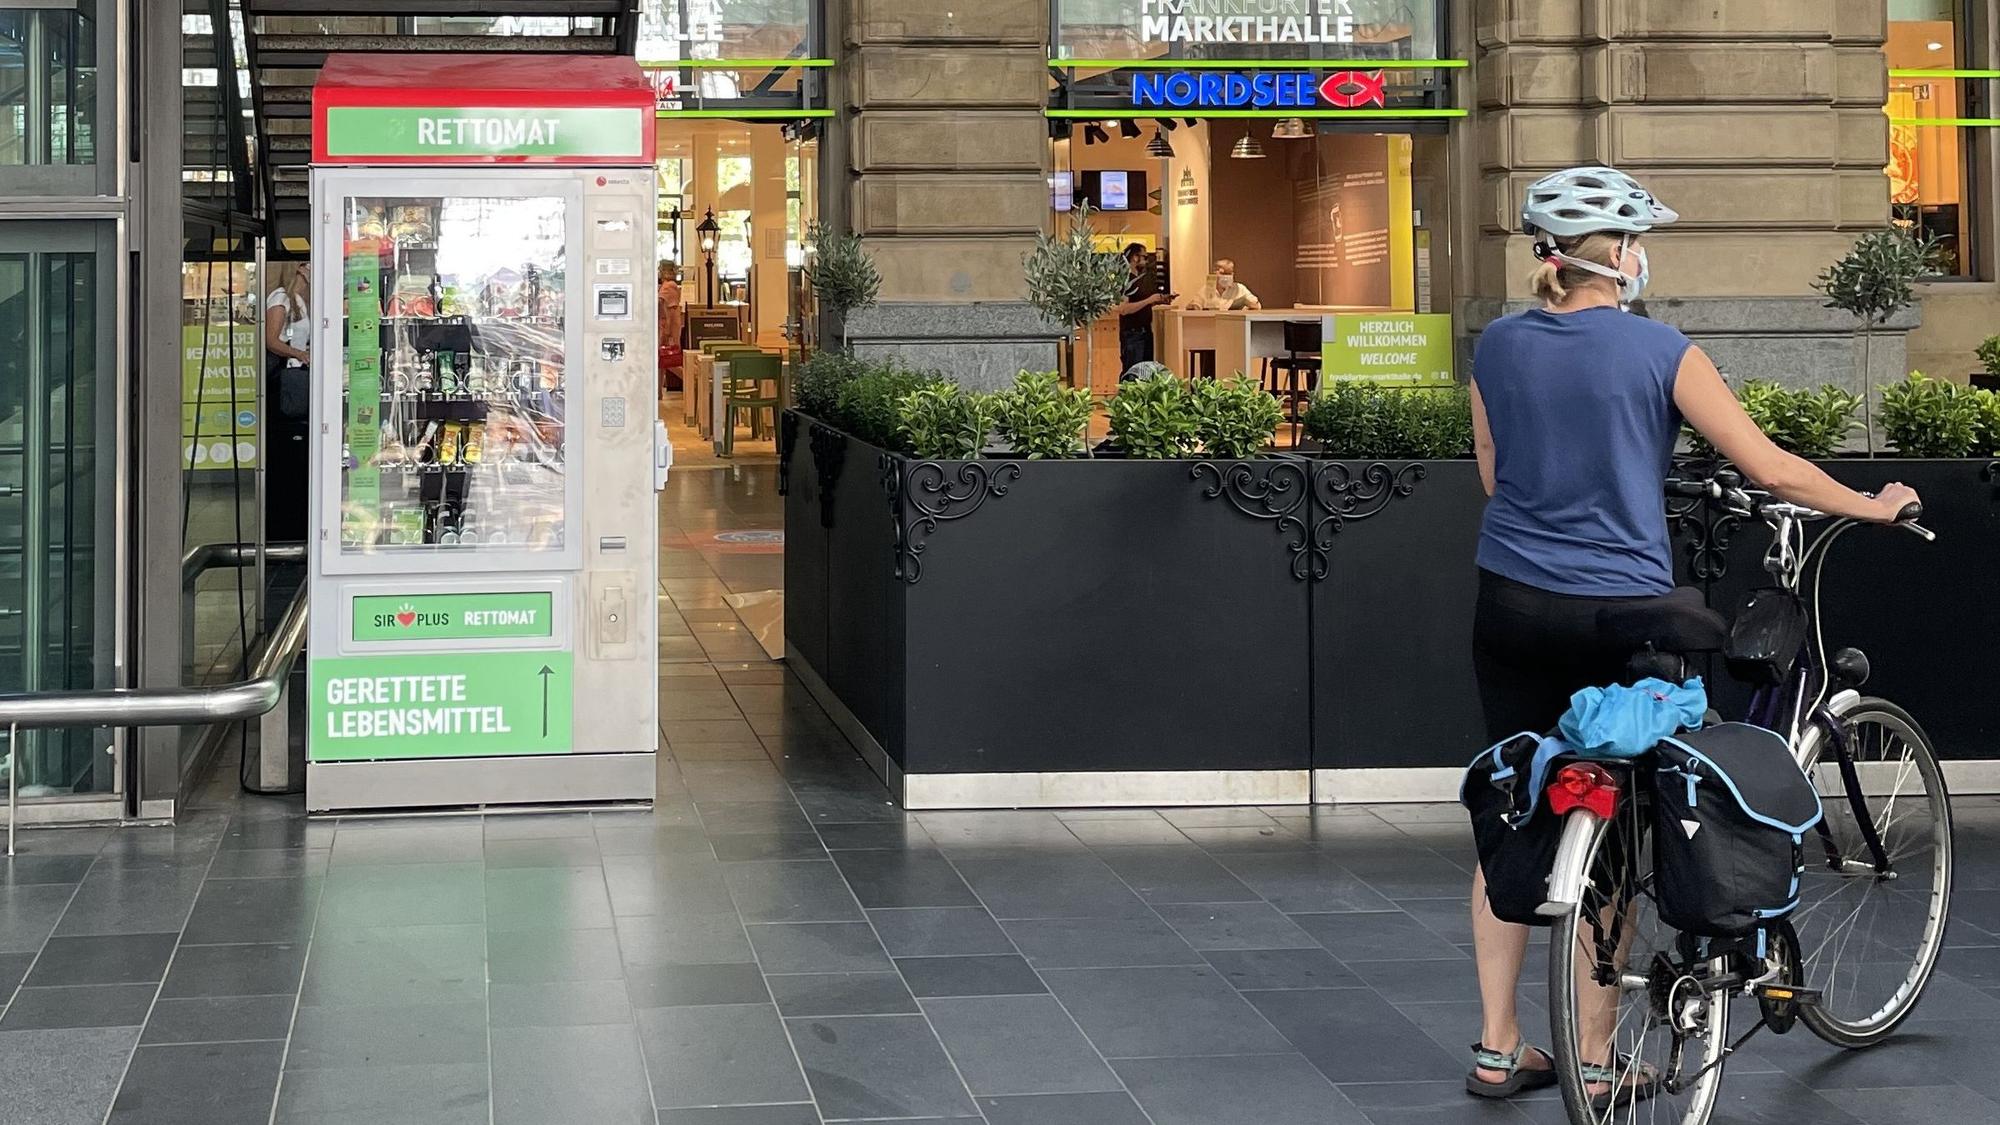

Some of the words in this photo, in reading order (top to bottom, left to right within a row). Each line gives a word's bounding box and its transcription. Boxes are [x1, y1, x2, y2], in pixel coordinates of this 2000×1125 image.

[1142, 15, 1353, 42] MARKTHALLE
[1132, 71, 1316, 107] NORDSEE
[418, 118, 560, 145] RETTOMAT
[1359, 321, 1414, 333] HERZLICH
[1347, 335, 1427, 347] WILLKOMMEN
[1360, 353, 1417, 365] WELCOME
[374, 614, 396, 628] SIR
[417, 613, 449, 626] PLUS
[464, 610, 537, 626] RETTOMAT
[327, 675, 467, 705] GERETTETE
[327, 706, 511, 738] LEBENSMITTEL
